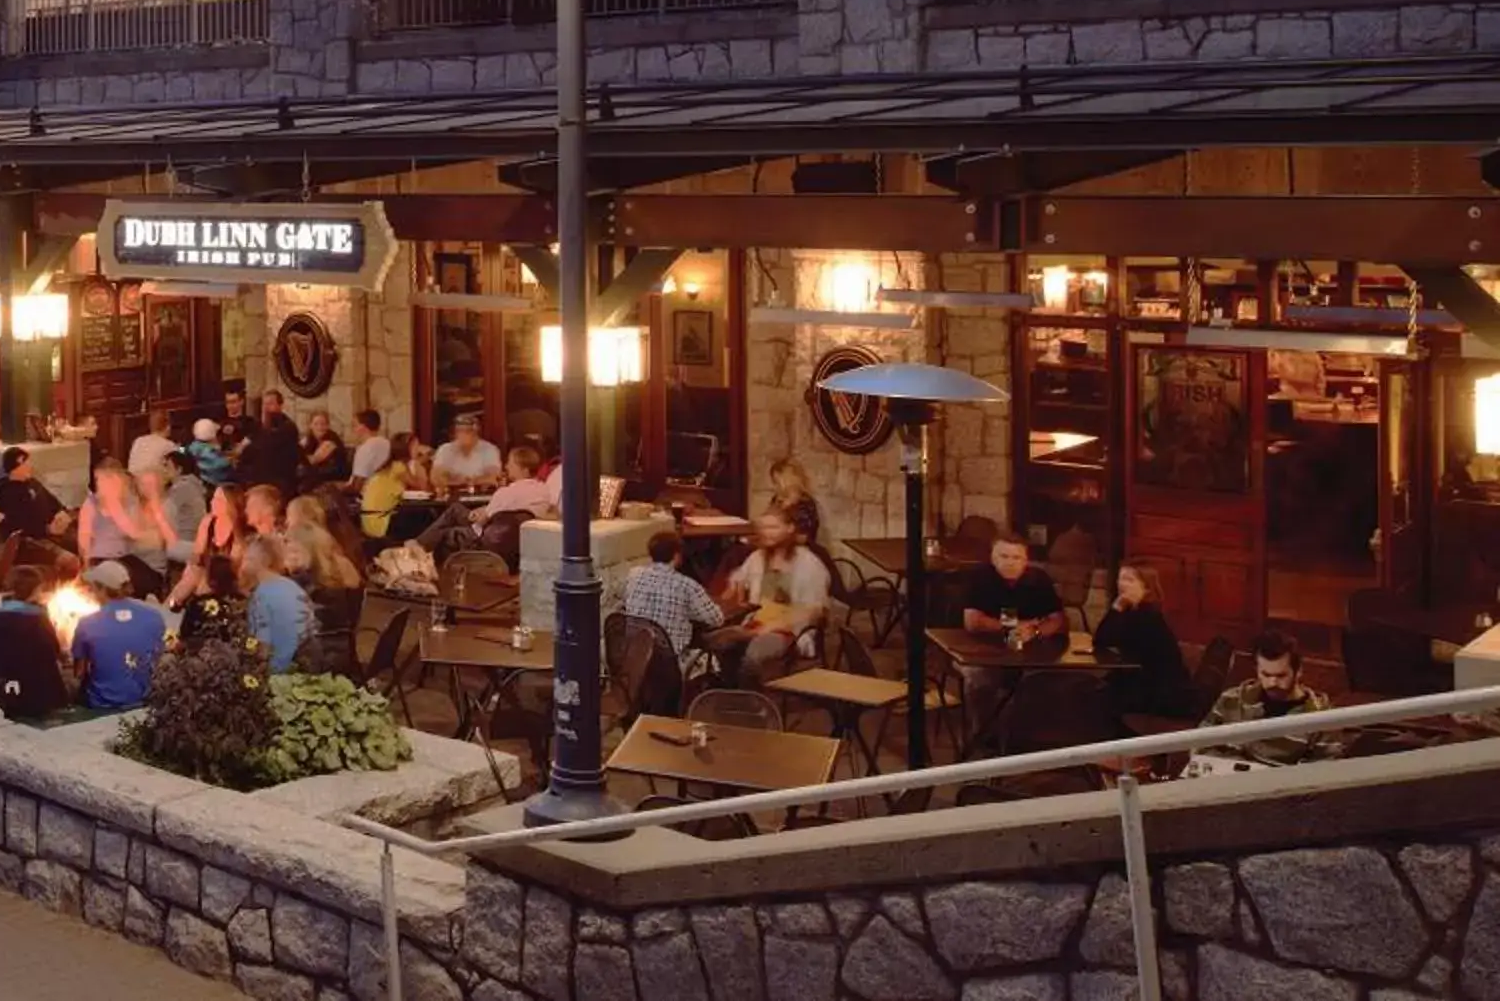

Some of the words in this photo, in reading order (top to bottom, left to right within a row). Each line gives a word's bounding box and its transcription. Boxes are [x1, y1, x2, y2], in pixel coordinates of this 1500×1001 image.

[123, 218, 197, 248] DUBH
[201, 221, 268, 249] LINN
[275, 222, 353, 254] GATE
[176, 250, 241, 265] IRISH
[246, 252, 292, 268] PUB
